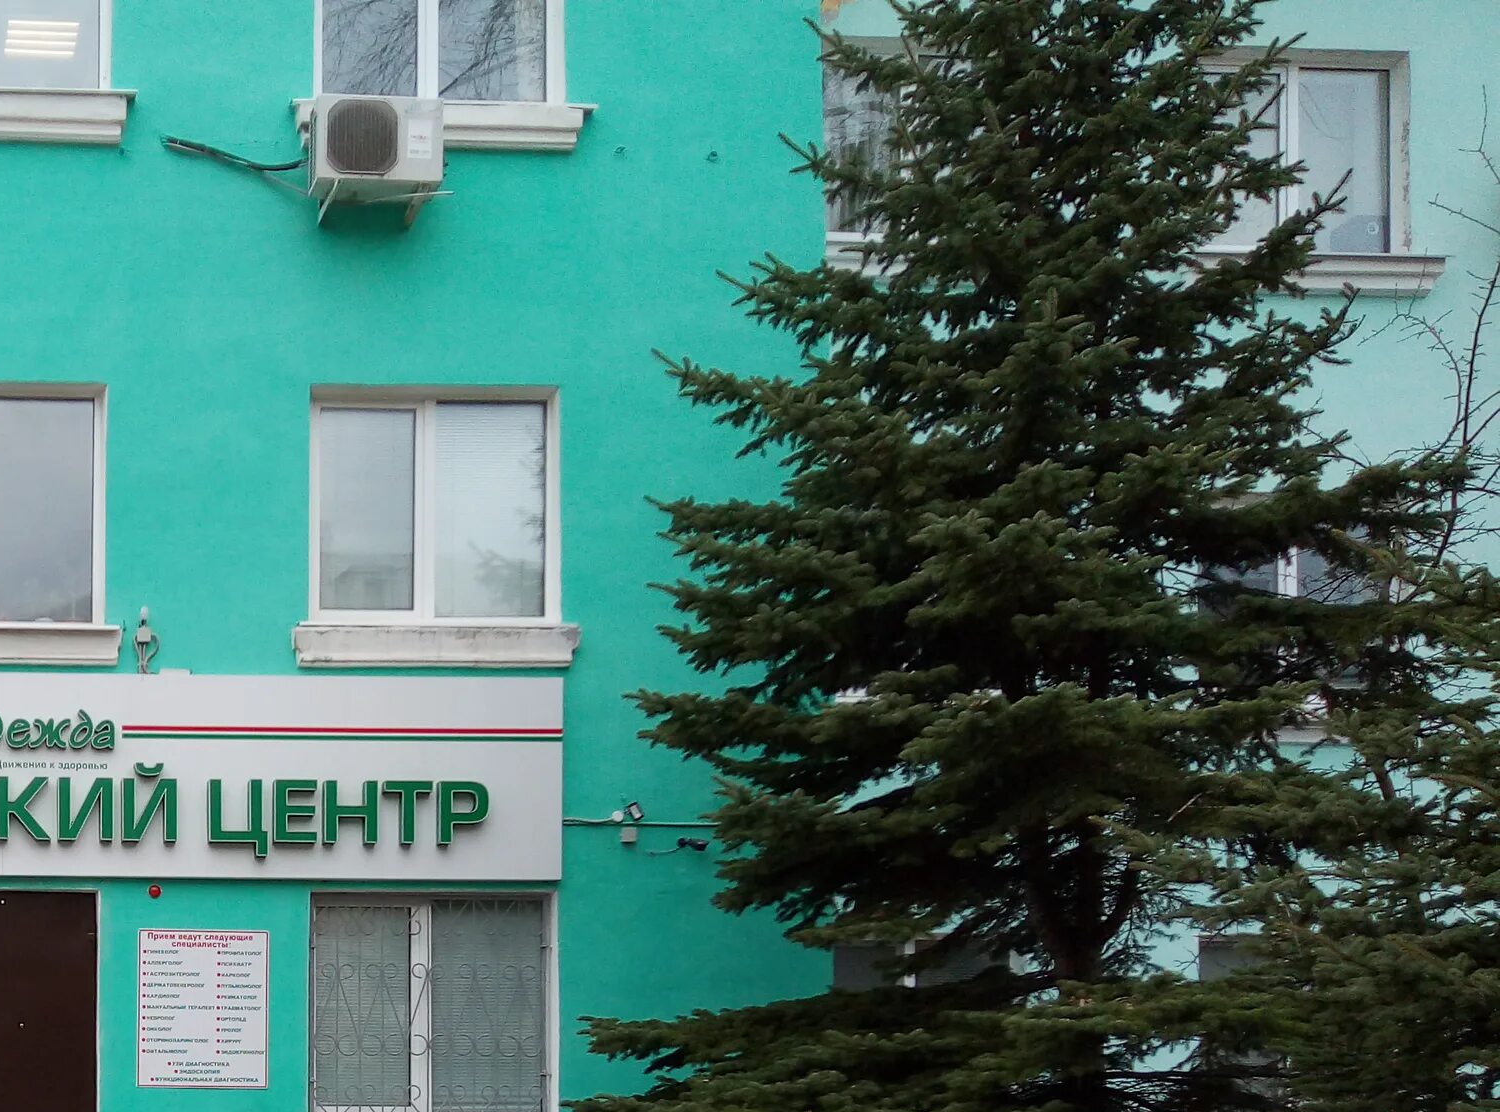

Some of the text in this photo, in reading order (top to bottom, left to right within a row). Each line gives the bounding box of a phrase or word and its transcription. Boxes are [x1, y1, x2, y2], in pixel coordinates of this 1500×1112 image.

[58, 762, 108, 772] здоровью
[206, 778, 491, 858] ЦЕНТР
[147, 932, 254, 942] Прием ведут следующие
